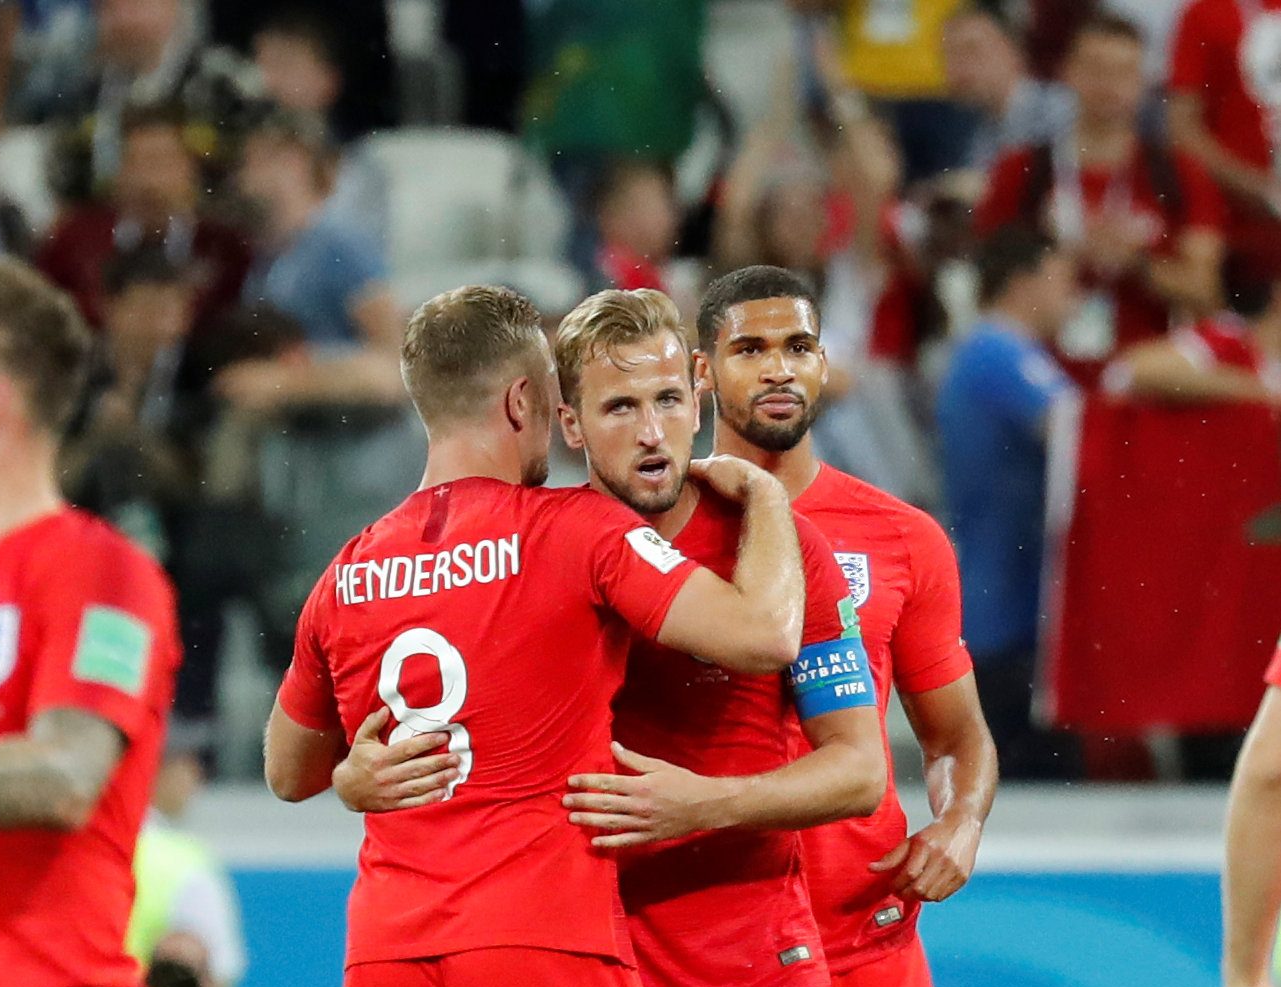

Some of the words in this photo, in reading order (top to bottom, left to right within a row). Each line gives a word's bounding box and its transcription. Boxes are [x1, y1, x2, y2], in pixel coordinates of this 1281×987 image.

[335, 533, 520, 606] HENDERSON
[378, 627, 473, 802] 8
[834, 681, 867, 697] FIFA
